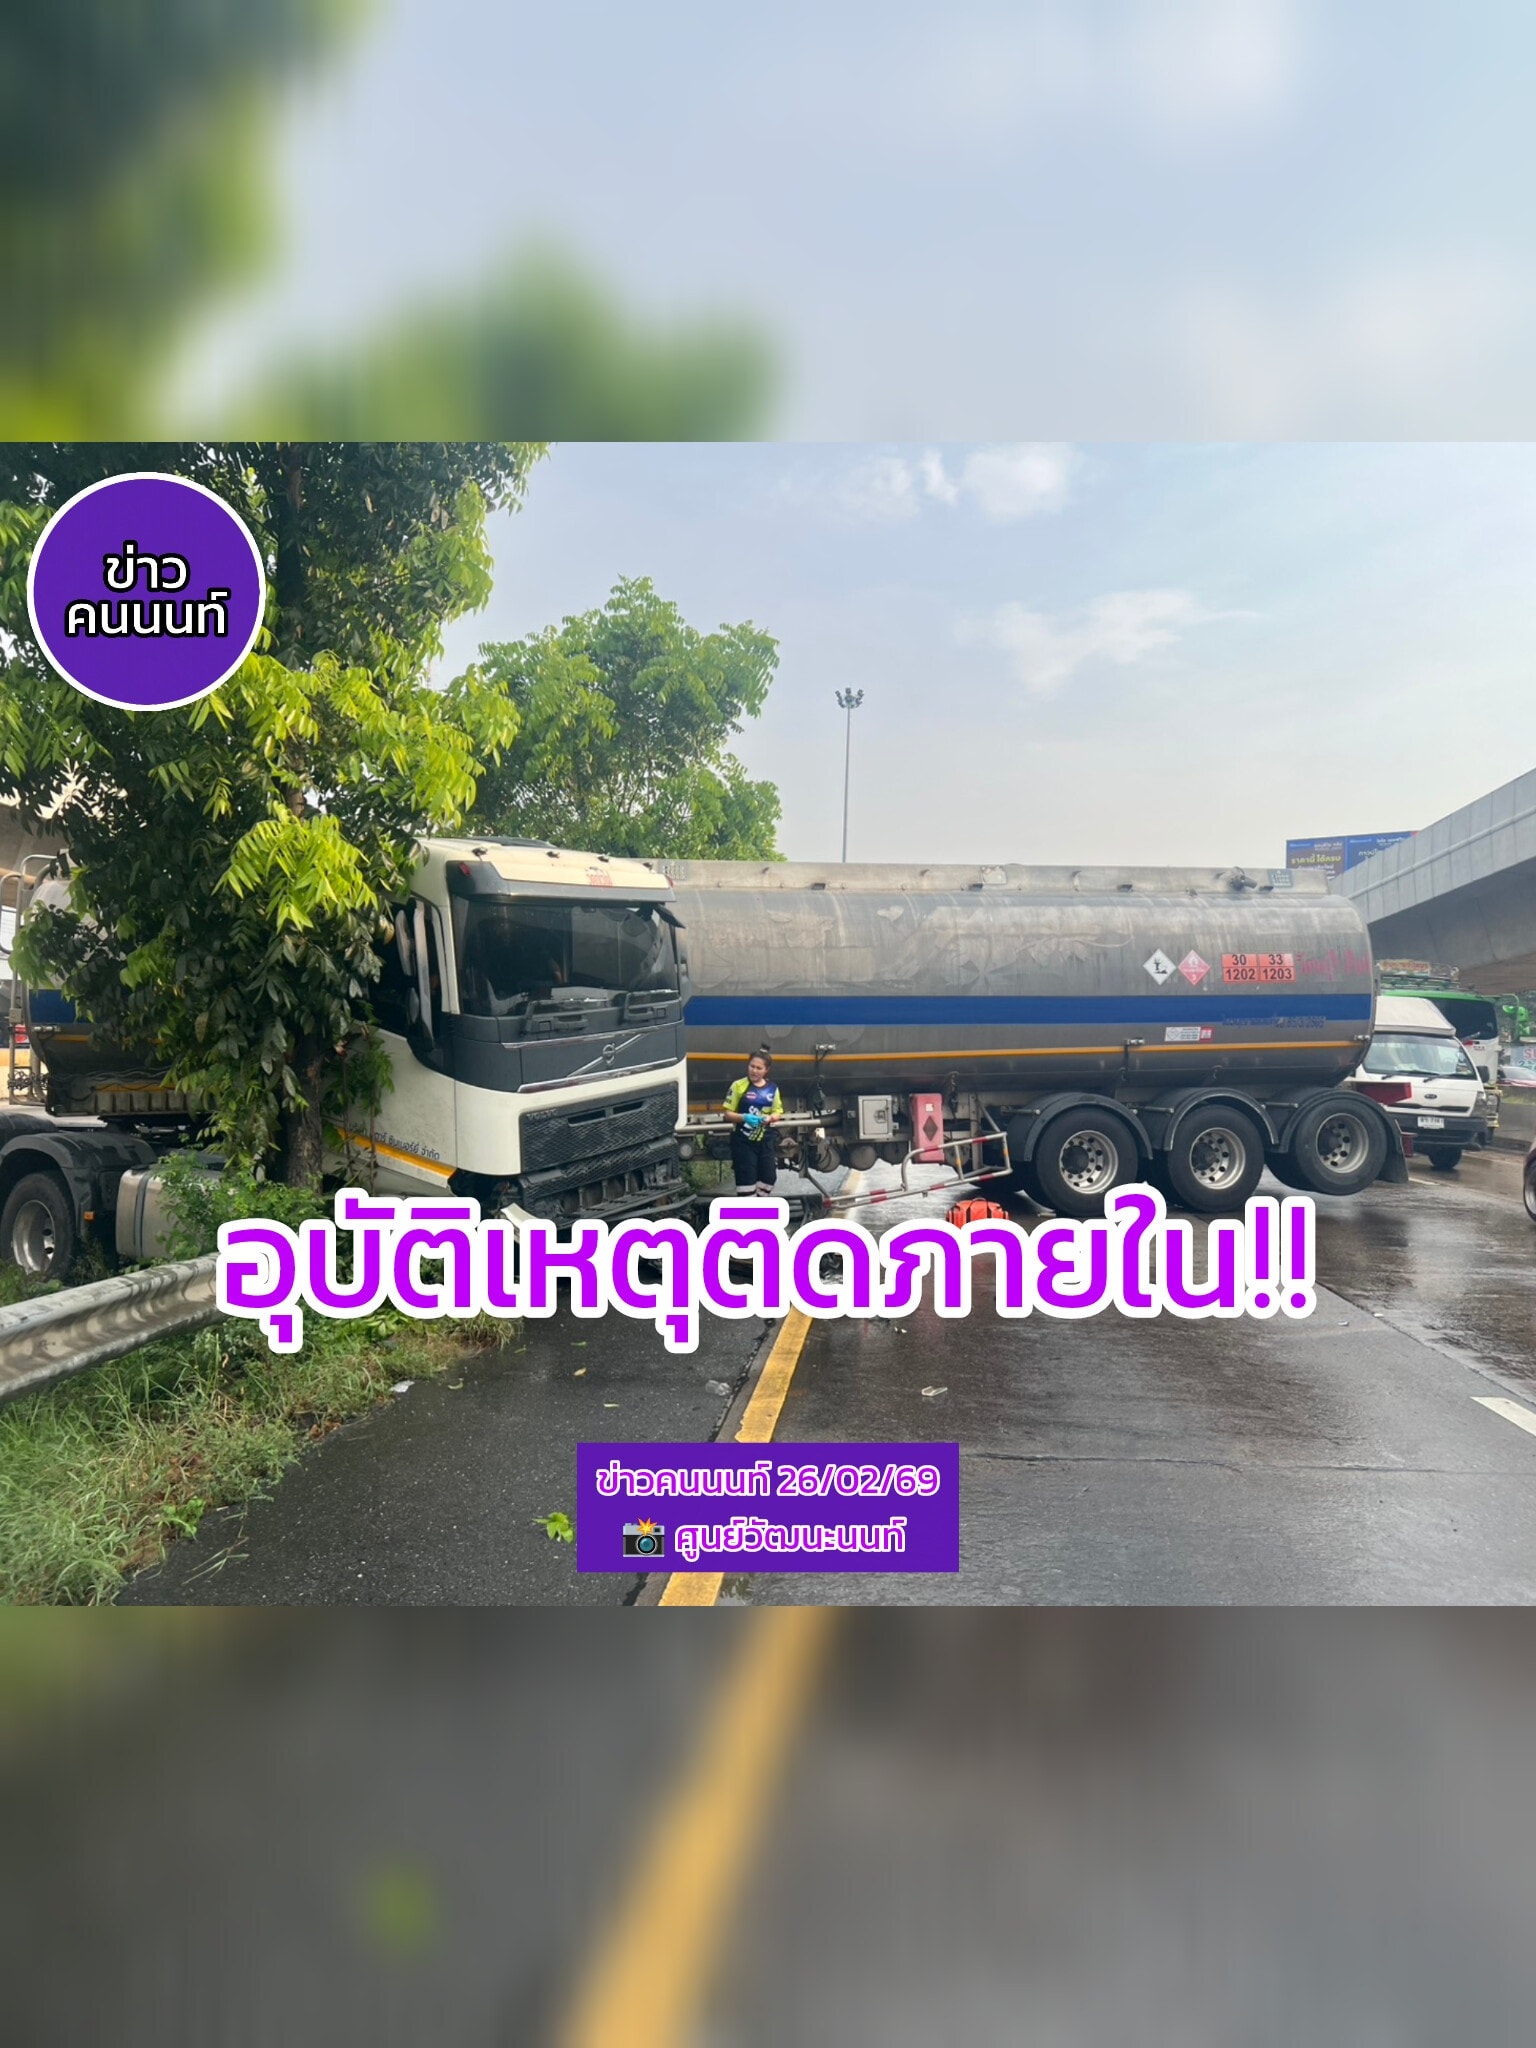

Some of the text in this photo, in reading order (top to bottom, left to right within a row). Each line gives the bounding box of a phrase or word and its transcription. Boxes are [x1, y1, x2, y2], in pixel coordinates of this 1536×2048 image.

[1231, 953, 1247, 966] 30
[1268, 953, 1284, 966] 33
[1225, 968, 1256, 981] 1202
[1262, 967, 1293, 980] 1203
[526, 1108, 559, 1121] VOLVO
[420, 1144, 441, 1161] จำกัด
